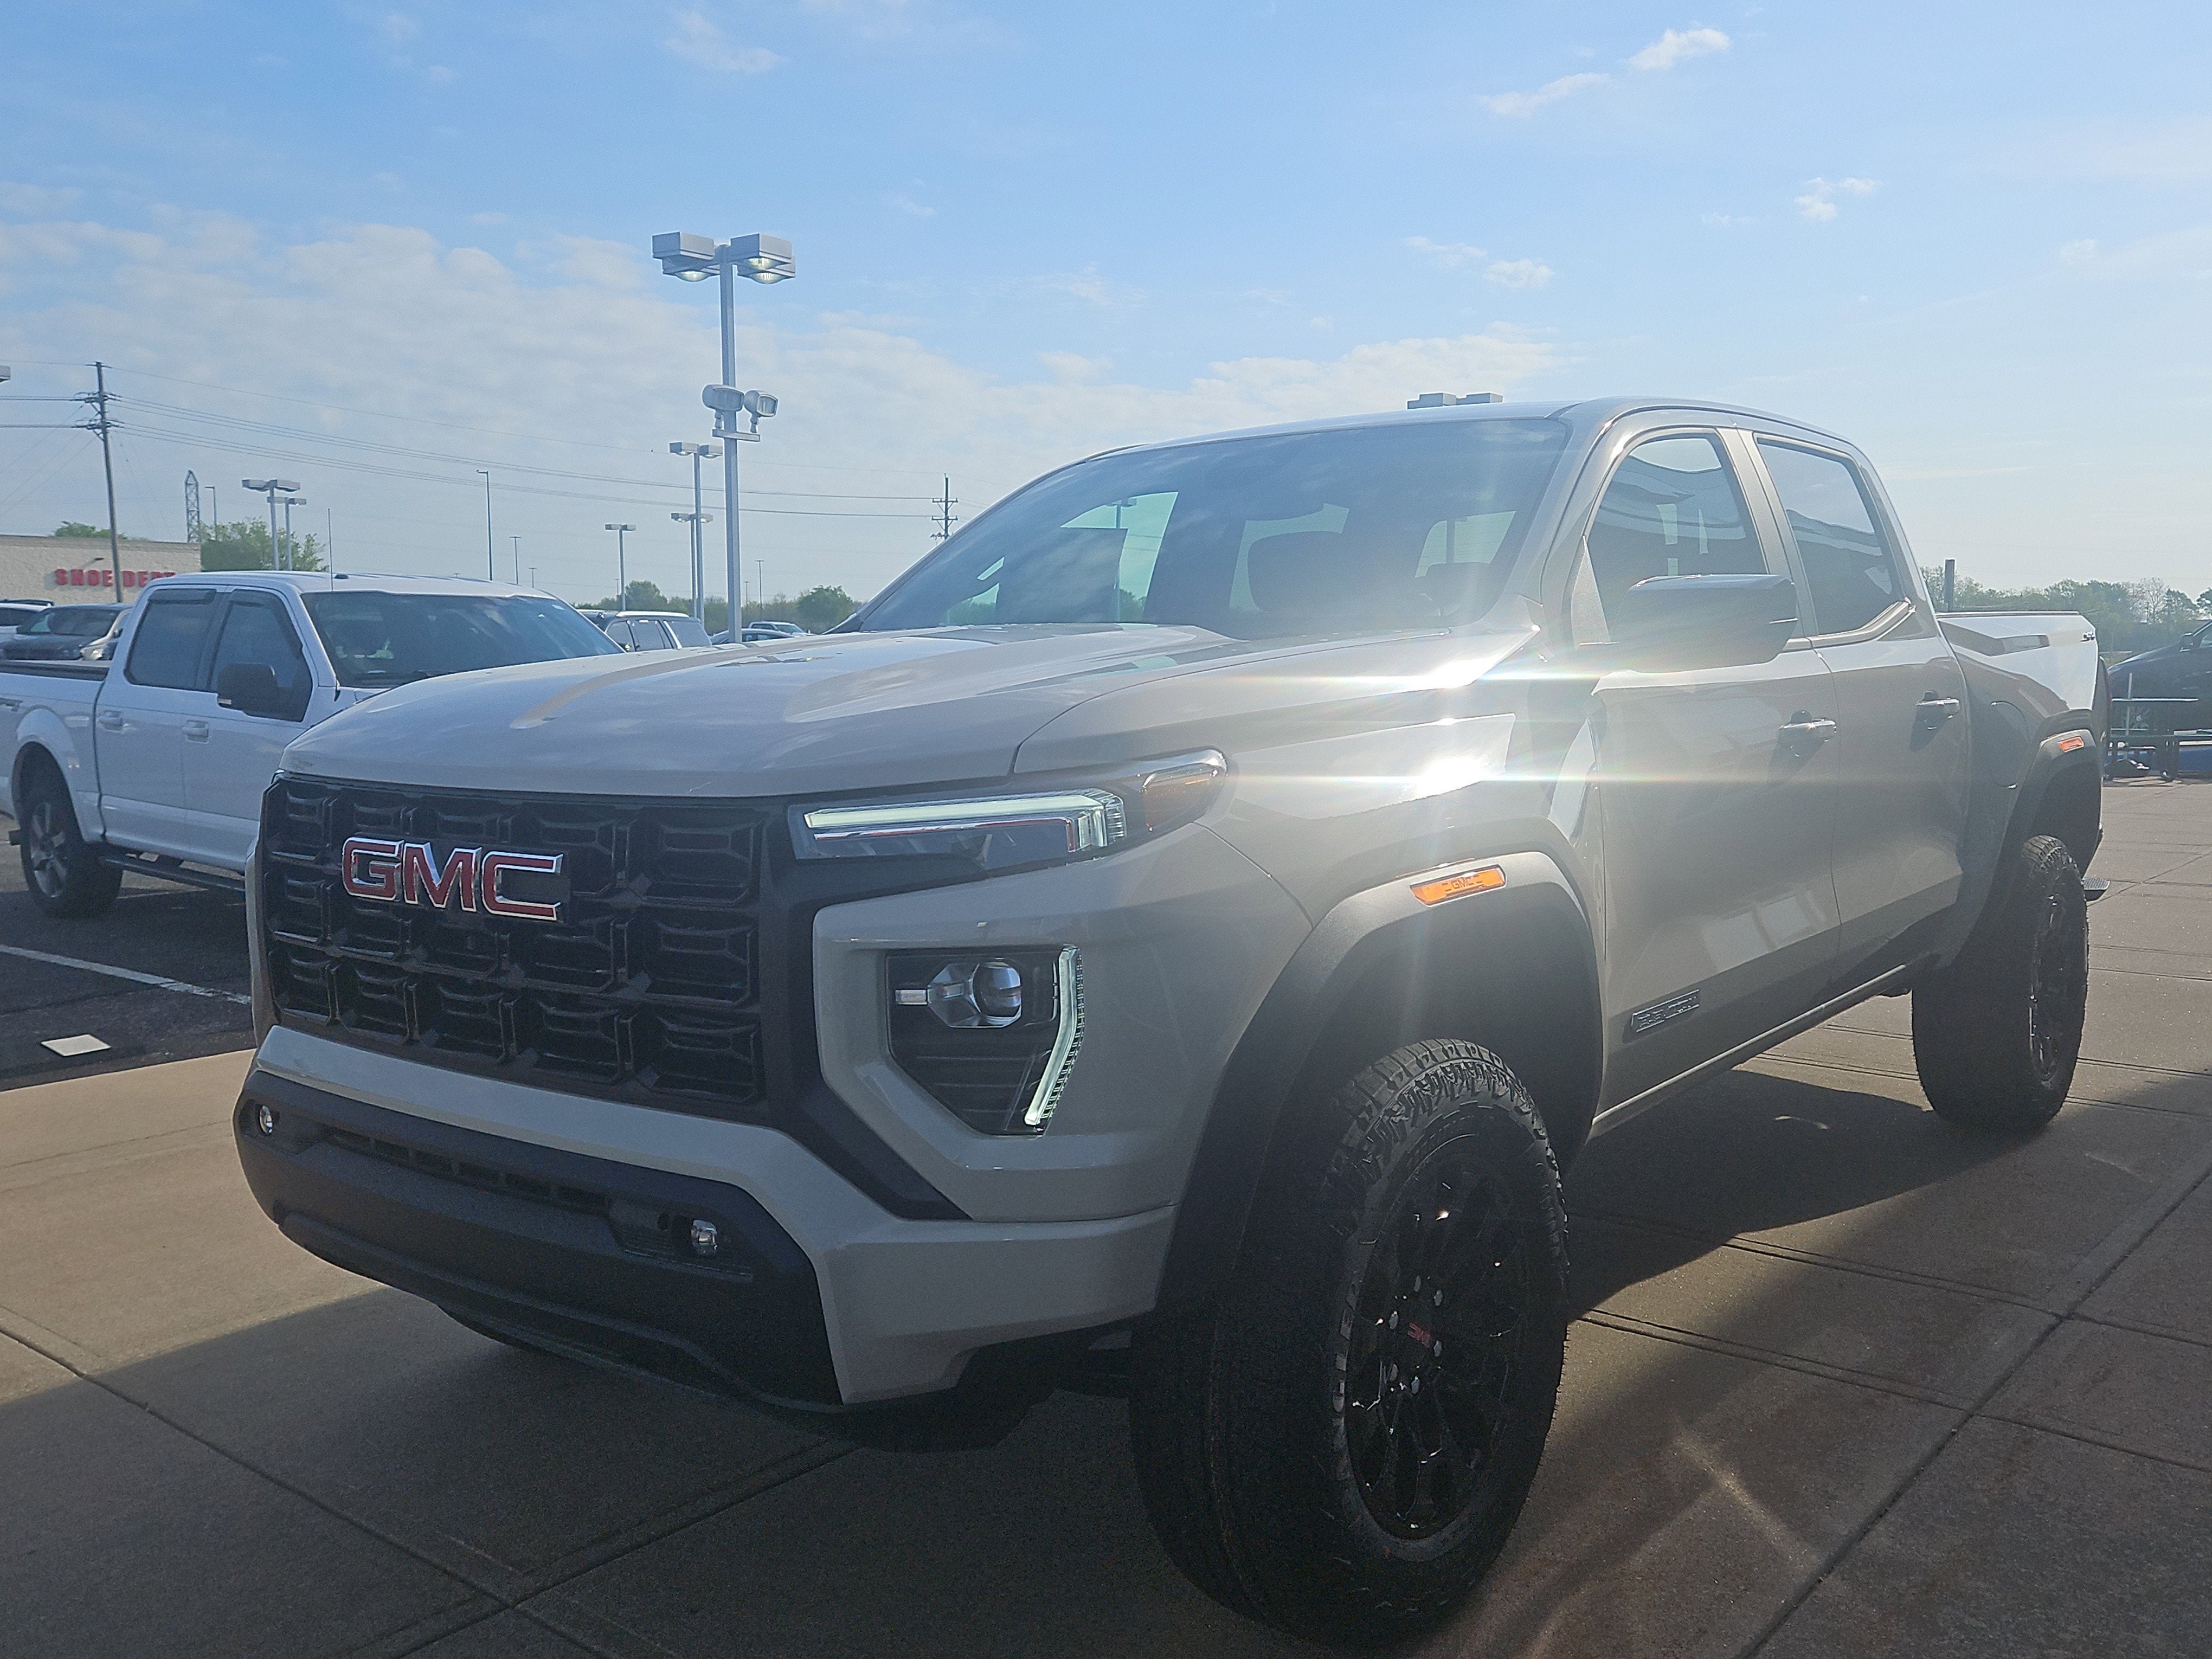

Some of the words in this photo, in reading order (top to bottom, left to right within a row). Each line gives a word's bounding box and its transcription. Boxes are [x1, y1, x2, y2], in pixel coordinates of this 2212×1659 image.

[55, 569, 113, 587] SHOE
[123, 570, 175, 587] DE
[342, 837, 564, 921] GMC
[1451, 877, 1474, 889] GMC
